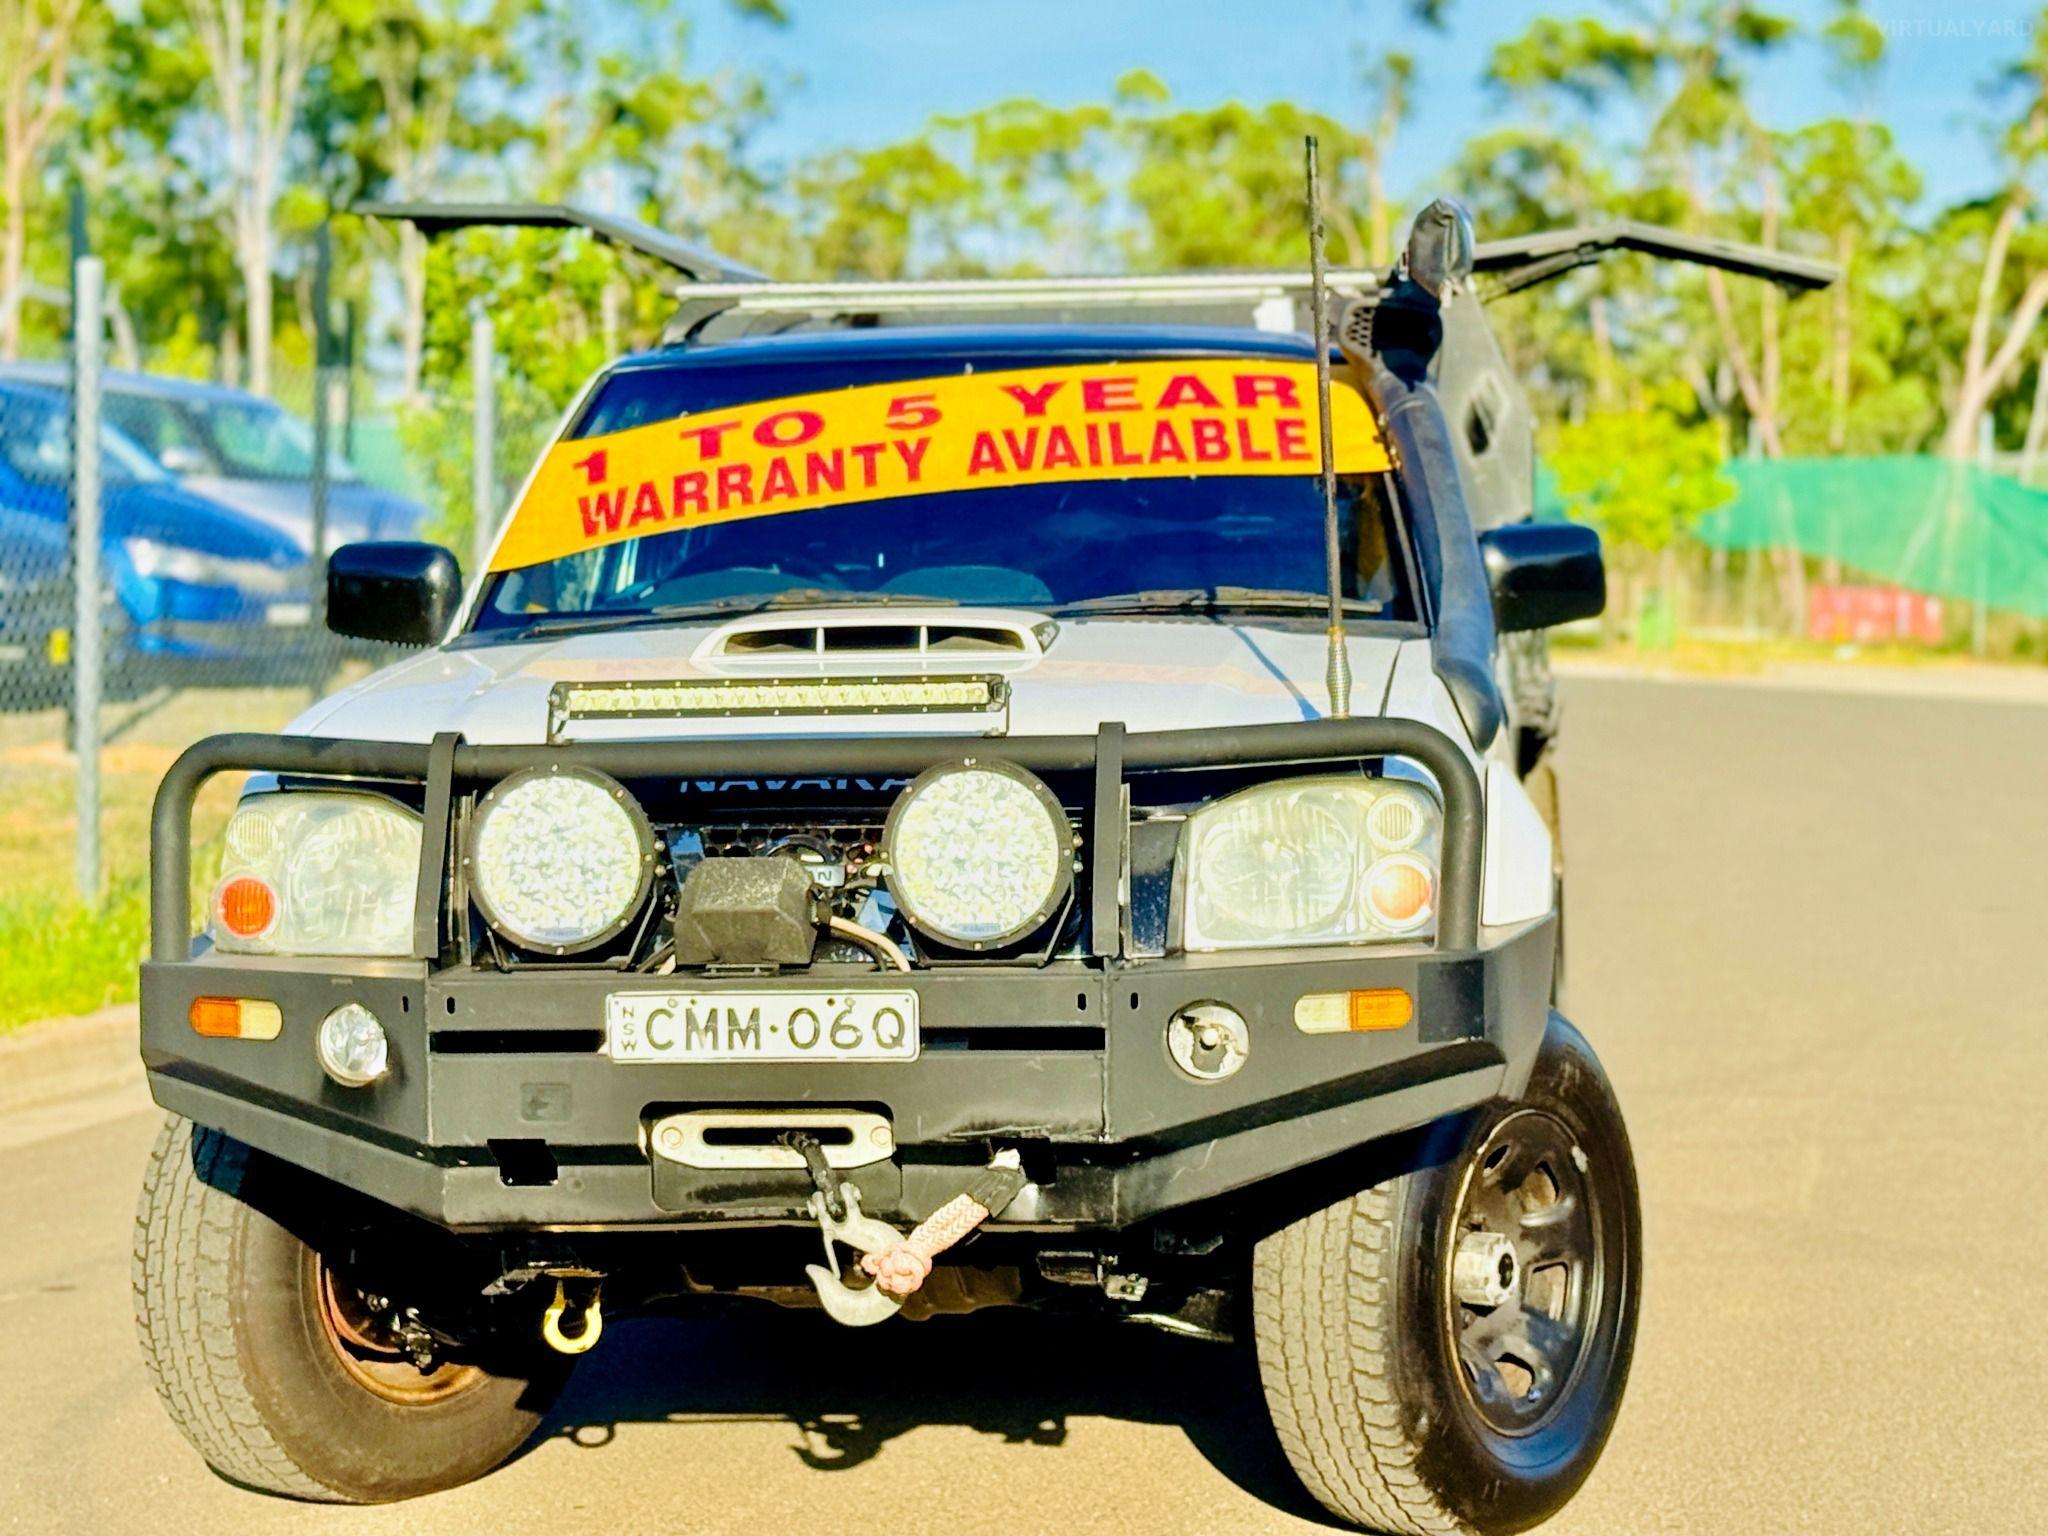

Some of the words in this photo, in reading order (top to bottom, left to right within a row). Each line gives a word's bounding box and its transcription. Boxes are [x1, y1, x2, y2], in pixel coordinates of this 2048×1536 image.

[573, 449, 608, 485] 1
[679, 410, 825, 461] TO
[884, 393, 943, 431] 5
[1000, 374, 1301, 417] YEAR
[578, 436, 932, 538] WARRANTY
[966, 417, 1313, 476] AVAILABLE
[620, 1006, 637, 1052] NSW
